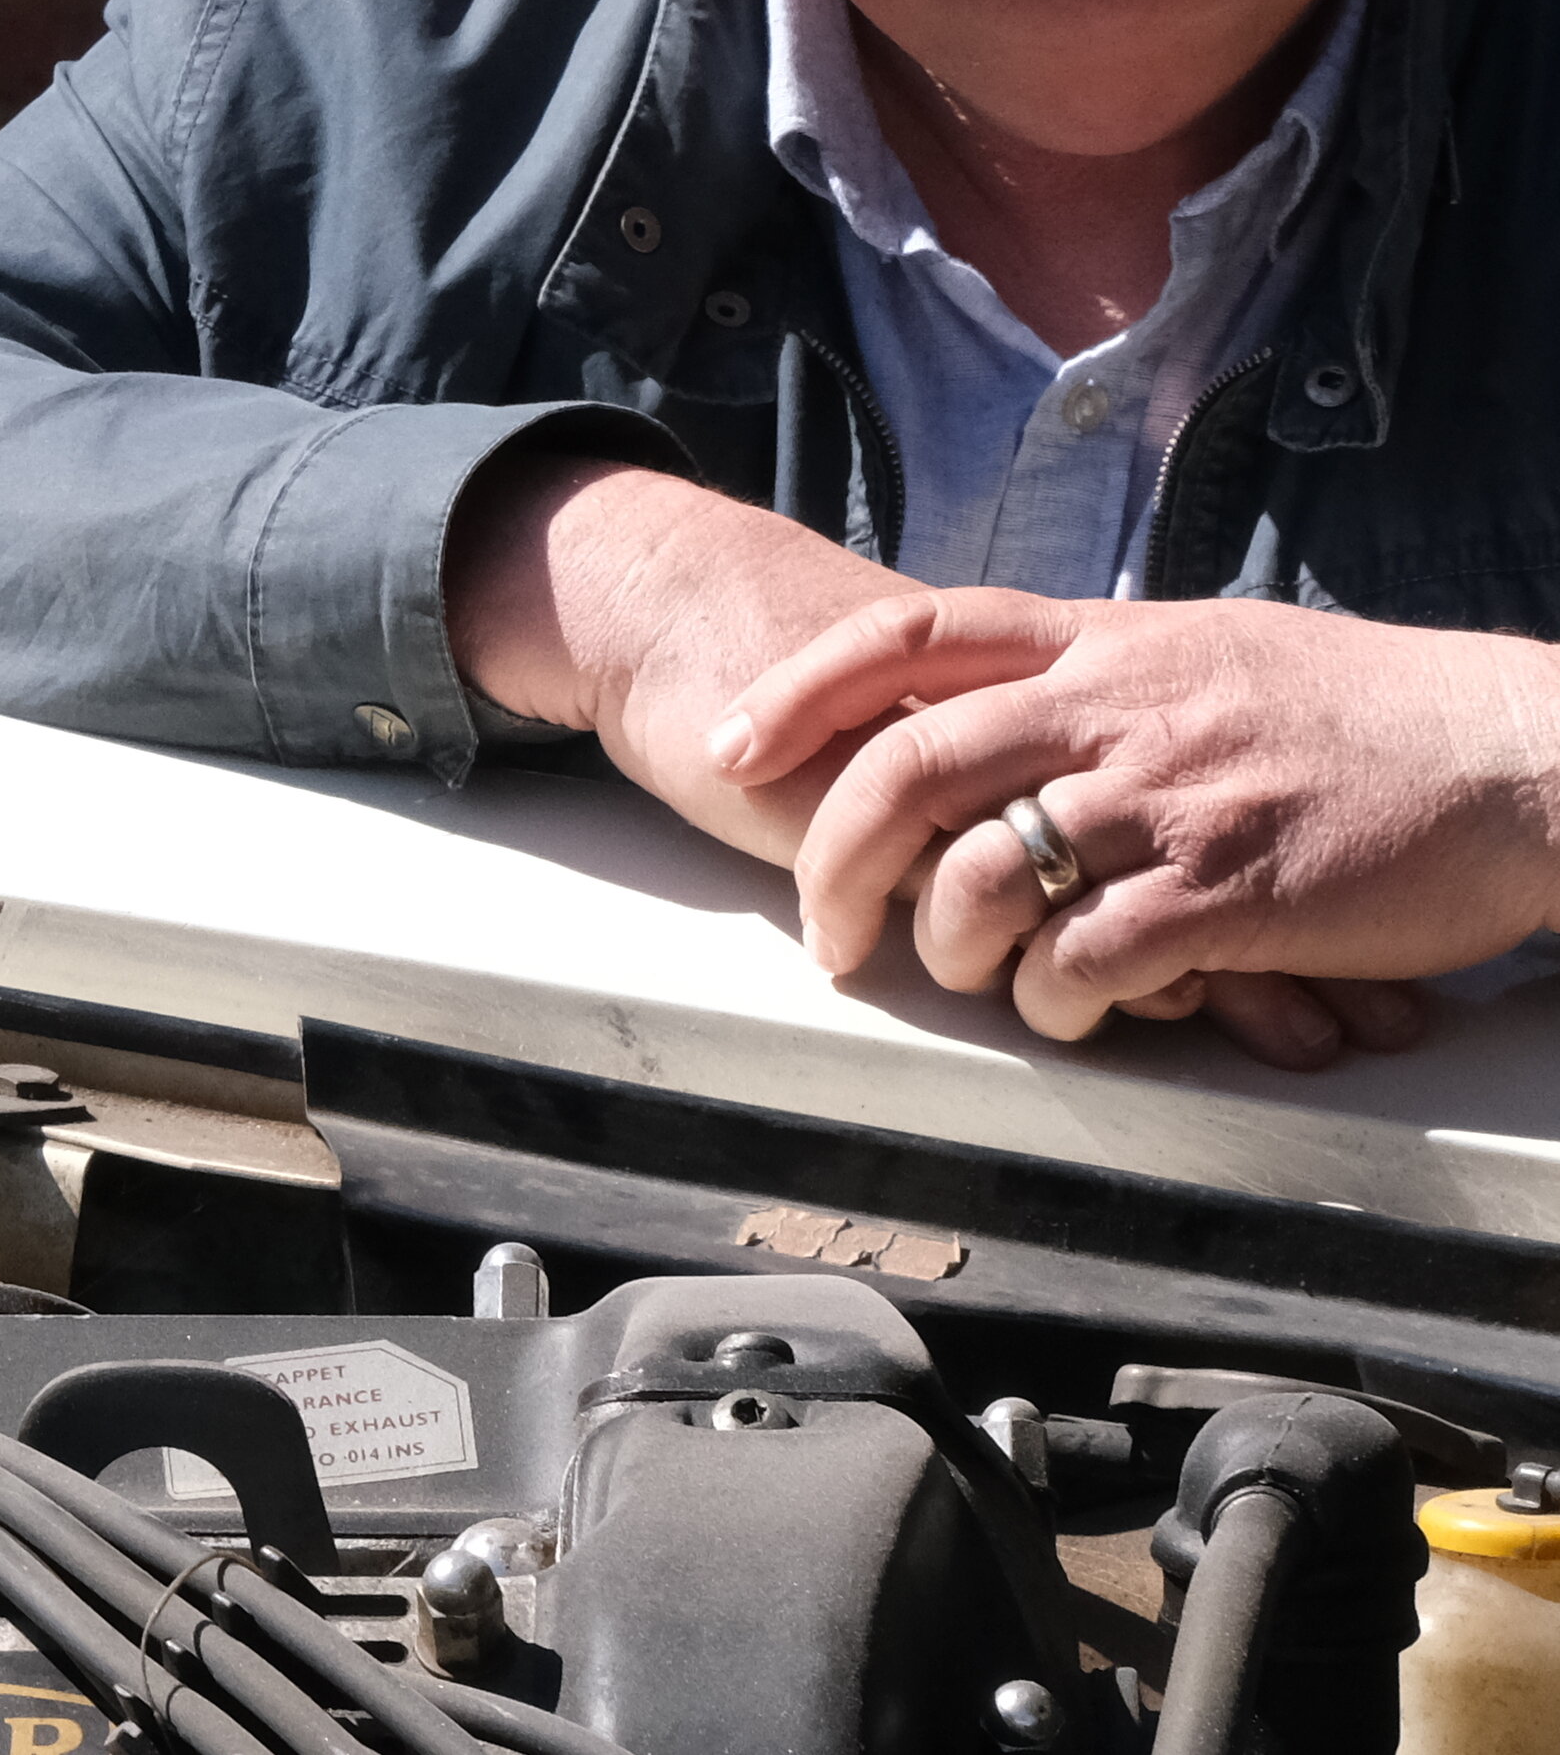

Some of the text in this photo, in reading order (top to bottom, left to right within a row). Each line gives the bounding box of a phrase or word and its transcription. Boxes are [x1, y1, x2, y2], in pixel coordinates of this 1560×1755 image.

[303, 1390, 382, 1410] RANCE
[330, 1410, 441, 1436] EXHAUST
[388, 1443, 424, 1458] INS
